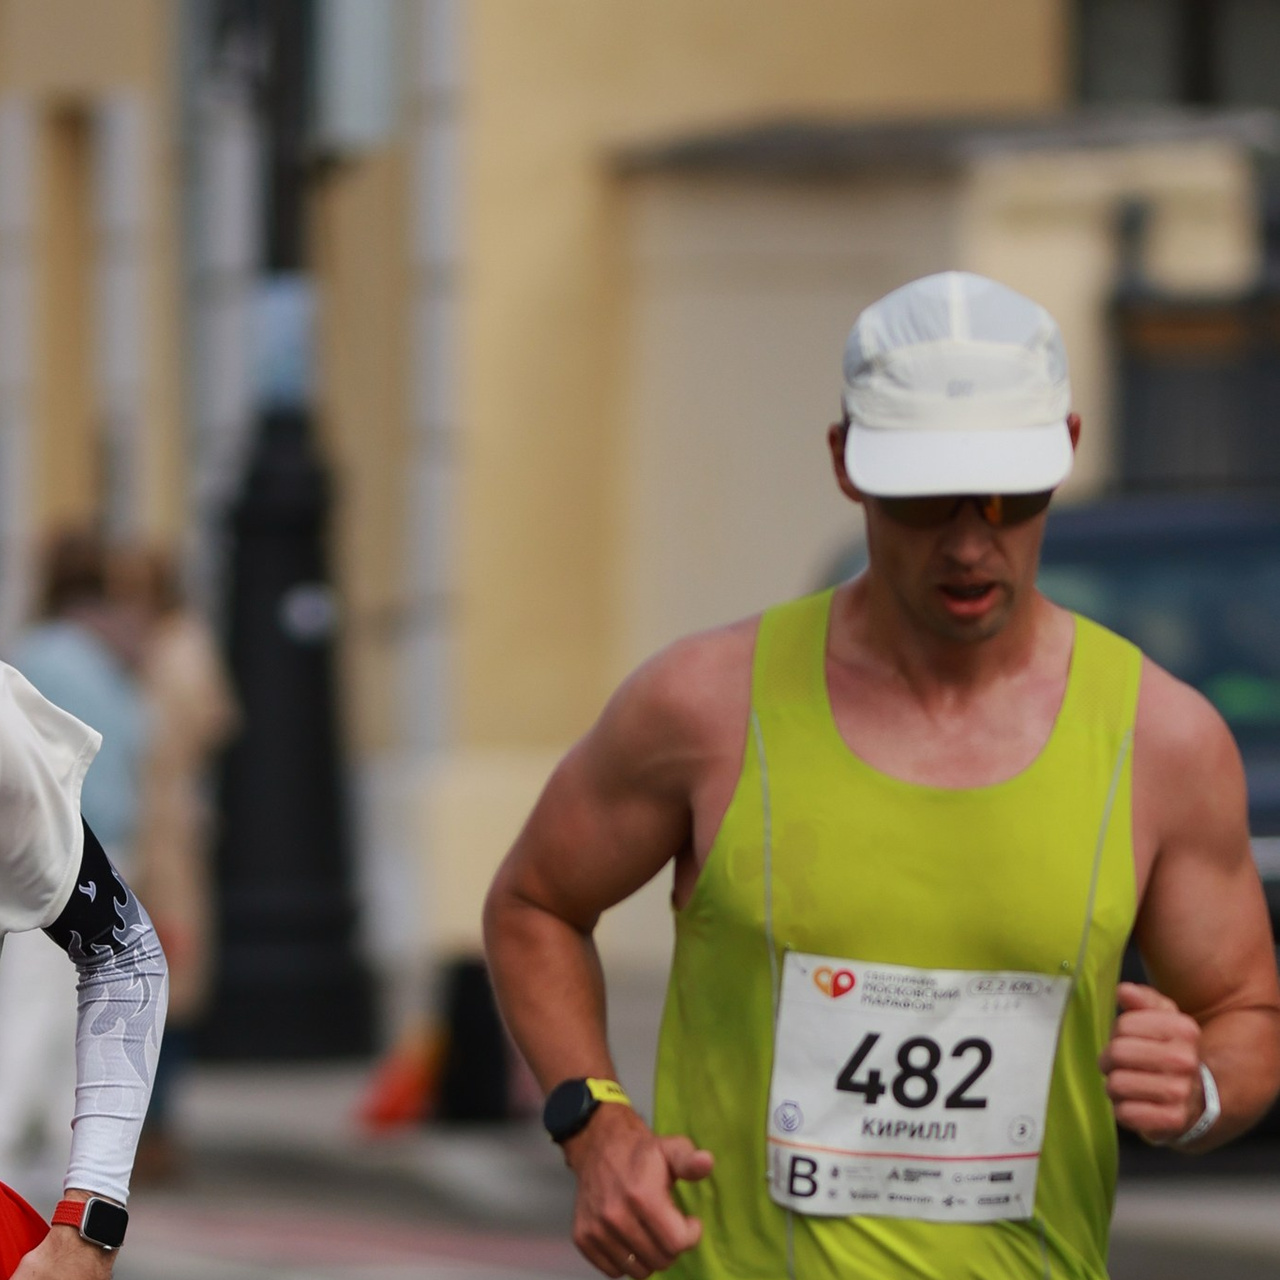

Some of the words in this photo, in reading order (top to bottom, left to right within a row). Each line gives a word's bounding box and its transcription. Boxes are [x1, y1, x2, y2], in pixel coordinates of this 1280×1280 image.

[835, 1031, 993, 1109] 482
[860, 1115, 958, 1142] КИРИЛЛ
[787, 1154, 818, 1198] B
